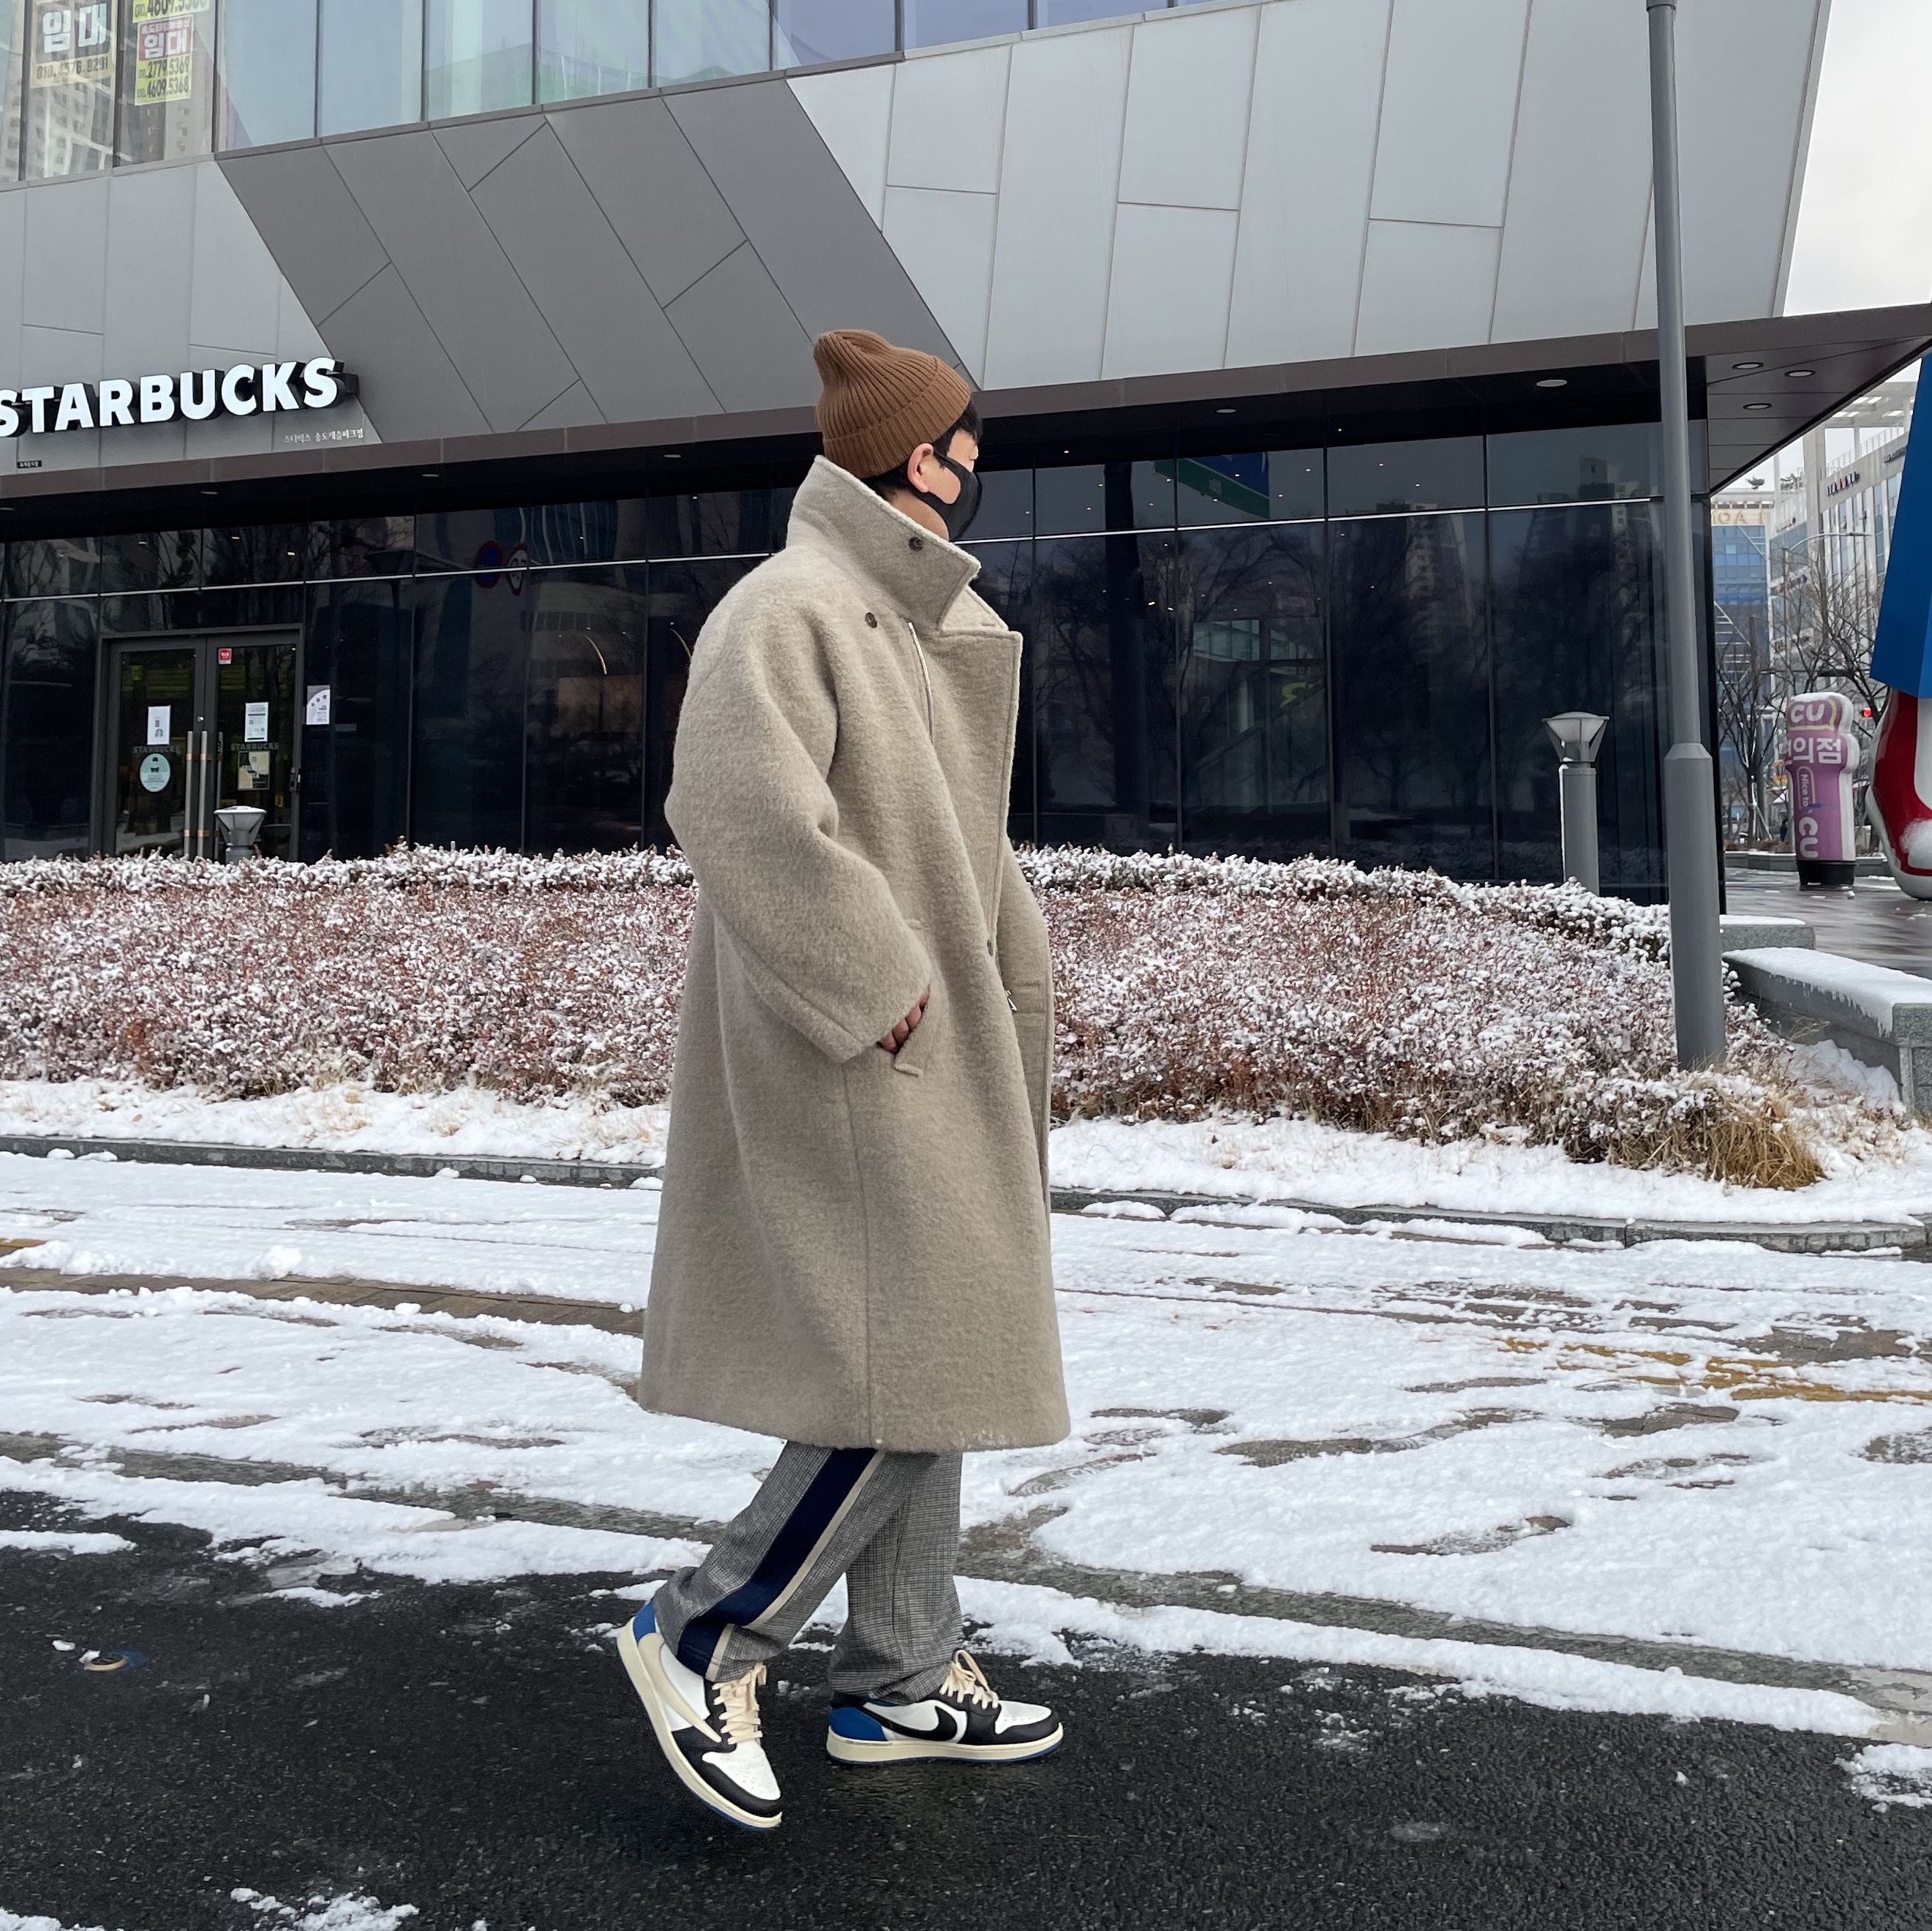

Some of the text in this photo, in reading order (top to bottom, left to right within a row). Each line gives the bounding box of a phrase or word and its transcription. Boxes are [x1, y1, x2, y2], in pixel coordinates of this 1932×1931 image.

[42, 3, 107, 53] 임대
[144, 29, 187, 59] 임대
[0, 357, 338, 437] STARBUCKS
[1790, 704, 1825, 723] CU
[1798, 816, 1819, 859] CU
